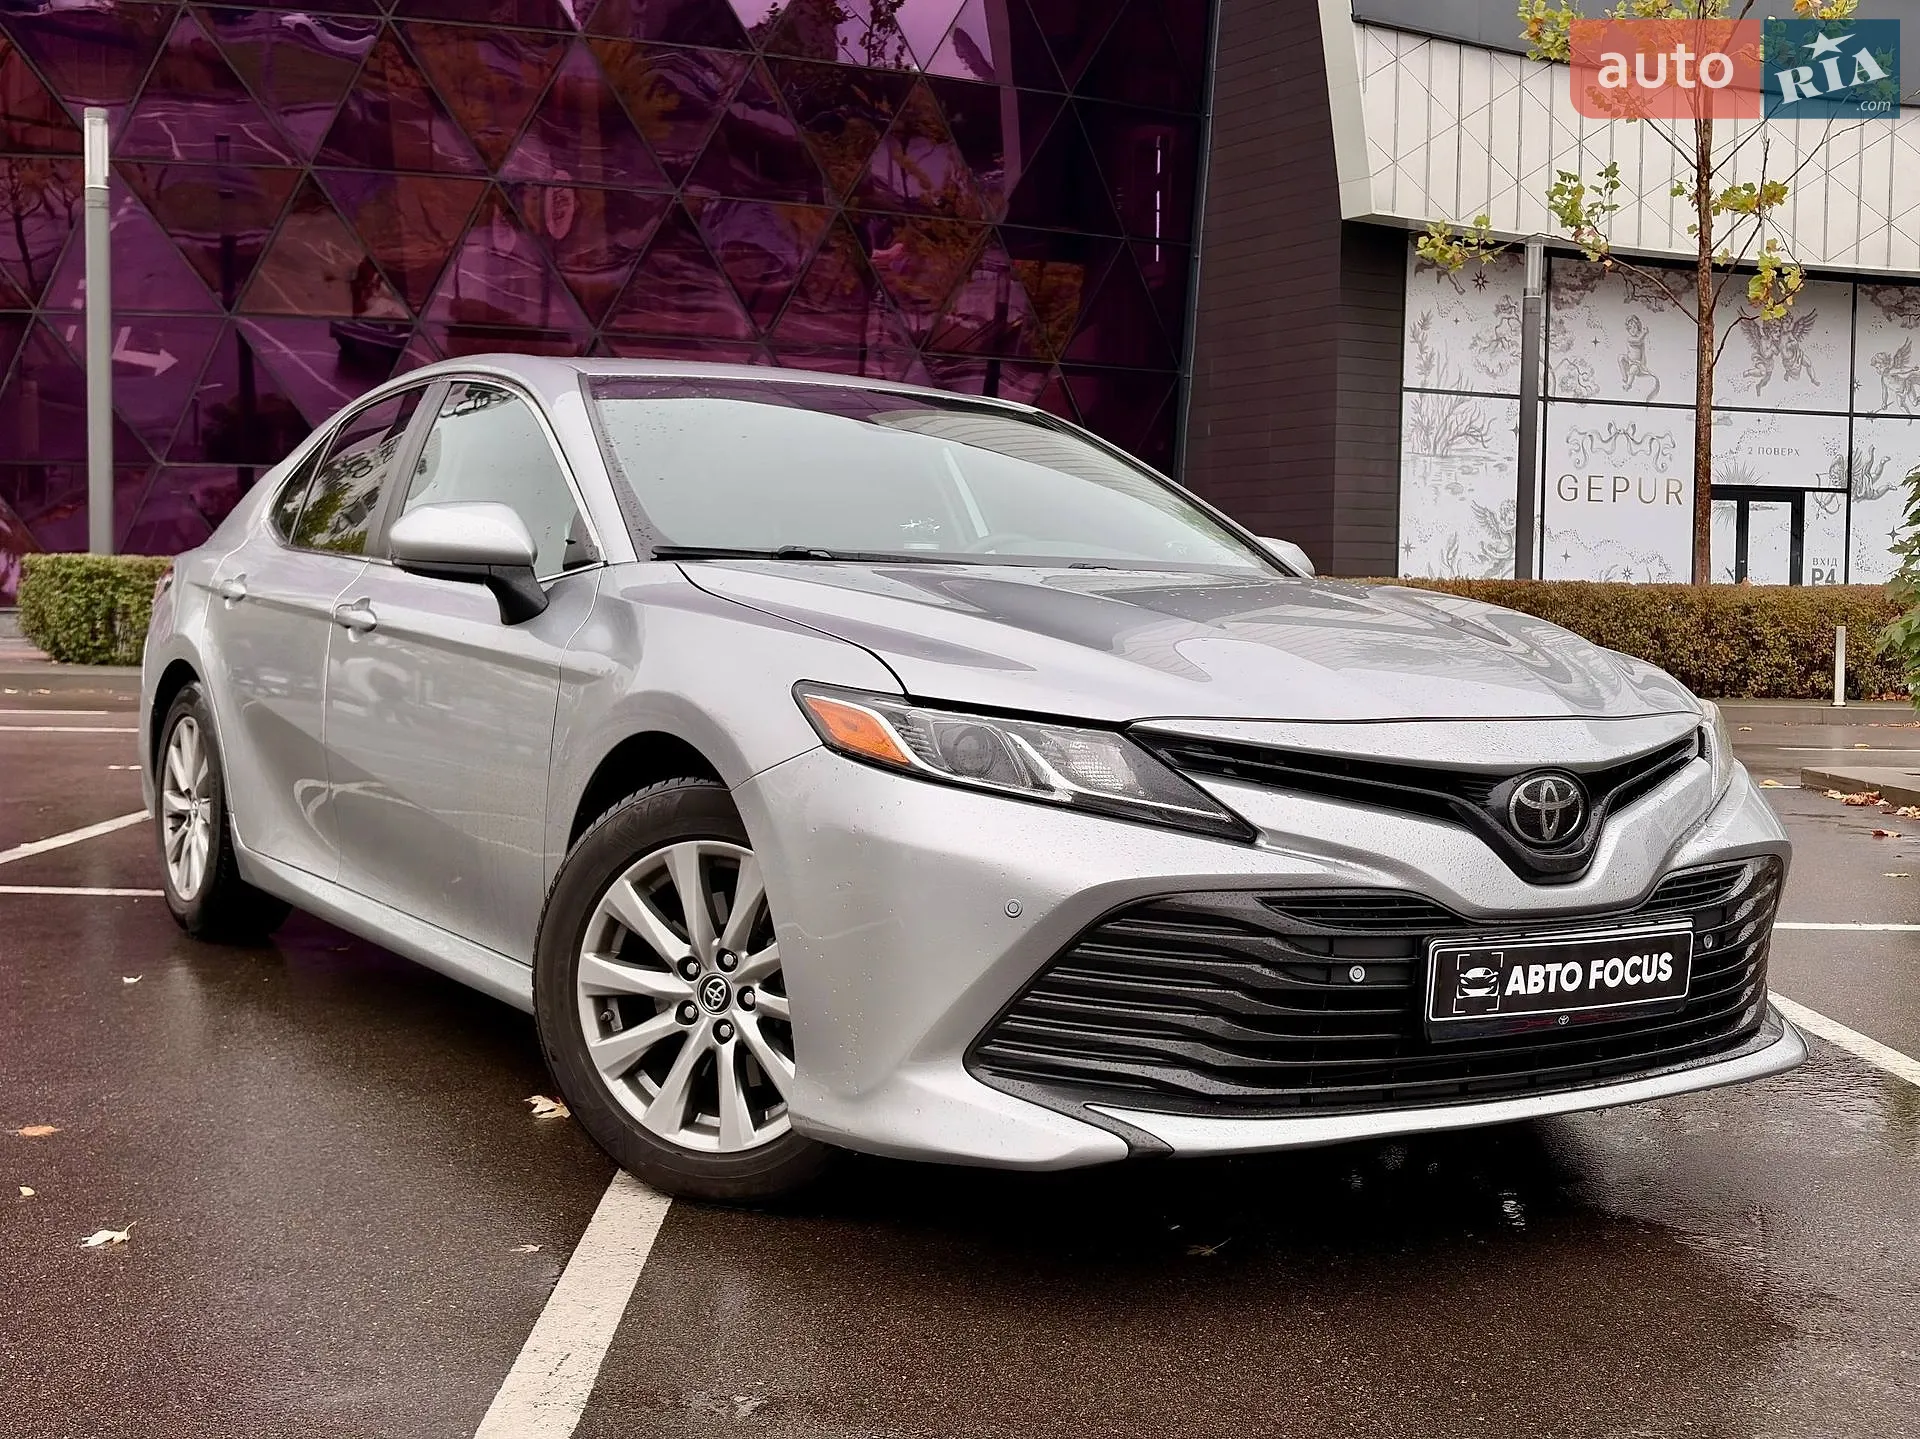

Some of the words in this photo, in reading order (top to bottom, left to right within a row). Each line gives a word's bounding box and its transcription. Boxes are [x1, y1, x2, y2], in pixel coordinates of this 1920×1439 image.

[1747, 446, 1753, 455] 2
[1757, 446, 1800, 457] ПОВЕРХ
[1557, 474, 1683, 505] GEPUR
[1812, 557, 1838, 567] ВХІД
[1504, 961, 1583, 996] АВТО
[1589, 952, 1673, 990] FOCUS
